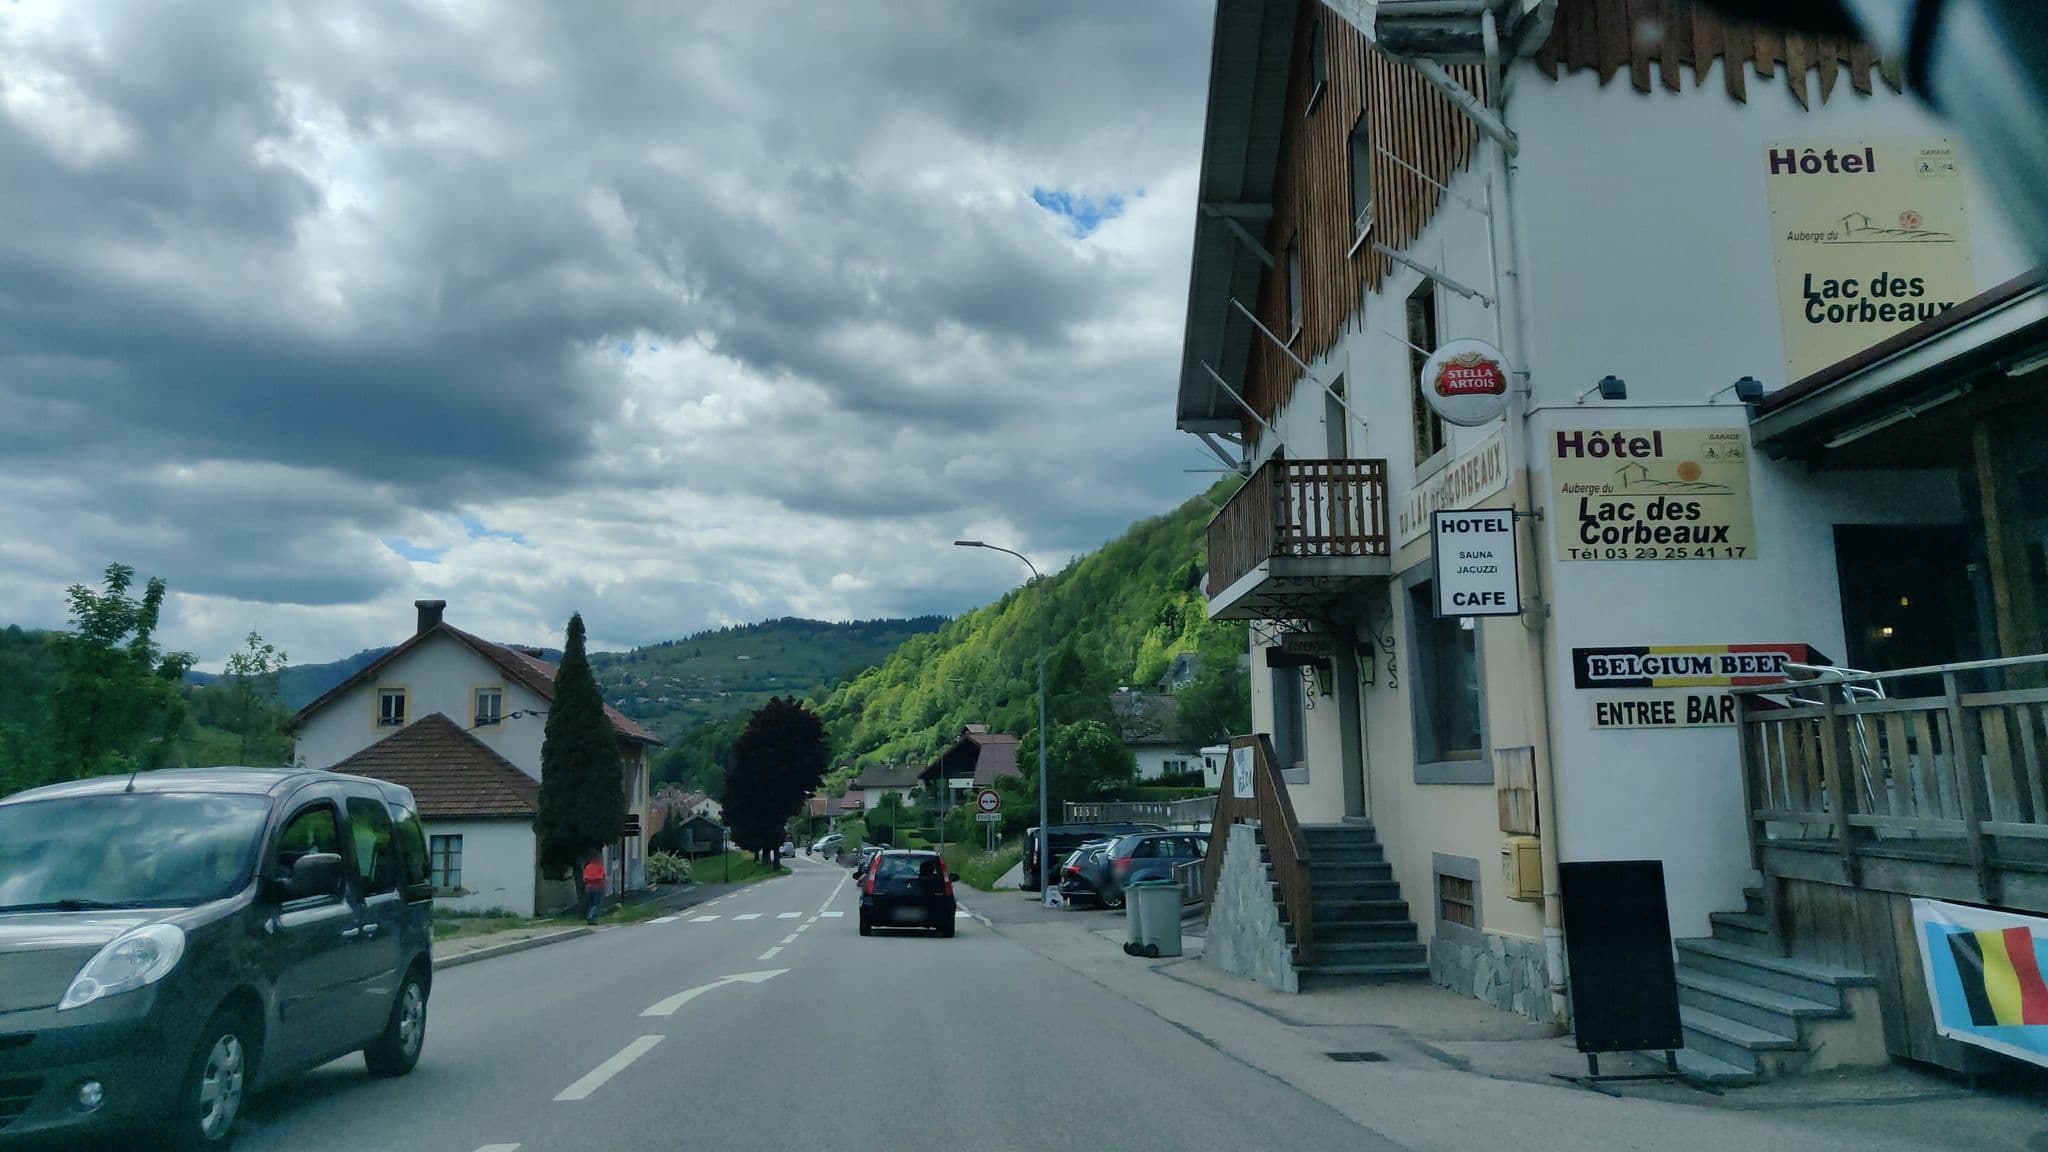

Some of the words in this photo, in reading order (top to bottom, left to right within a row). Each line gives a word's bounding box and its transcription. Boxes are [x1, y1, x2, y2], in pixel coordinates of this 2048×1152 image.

[1769, 147, 1876, 175] Hôtel
[1787, 230, 1825, 243] Auberge
[1827, 230, 1839, 241] du
[1803, 273, 1860, 300] Lac
[1870, 271, 1925, 298] des
[1448, 368, 1493, 380] STELLA
[1449, 378, 1495, 389] ARTOIS
[1556, 430, 1664, 459] Hôtel
[1410, 491, 1428, 530] LAC
[1447, 442, 1502, 504] CORBEAUX
[1561, 482, 1601, 495] Auberge
[1602, 482, 1614, 493] du
[1579, 496, 1635, 522] Lac
[1646, 496, 1701, 521] des
[1441, 519, 1509, 534] HOTEL
[1580, 520, 1730, 545] Corbeaux
[1459, 551, 1494, 560] SAUNA
[1567, 547, 1598, 560] Tél
[1605, 547, 1628, 560] 03
[1635, 547, 1658, 559] 29
[1665, 547, 1688, 559] 25
[1694, 546, 1716, 558] 41
[1726, 546, 1746, 558] 17
[1457, 565, 1498, 574] JACUZZI
[1452, 591, 1506, 606] CAFE
[1591, 656, 1713, 677] BELGIUM
[1596, 701, 1676, 726] ENTREE
[1686, 695, 1736, 724] BAR
